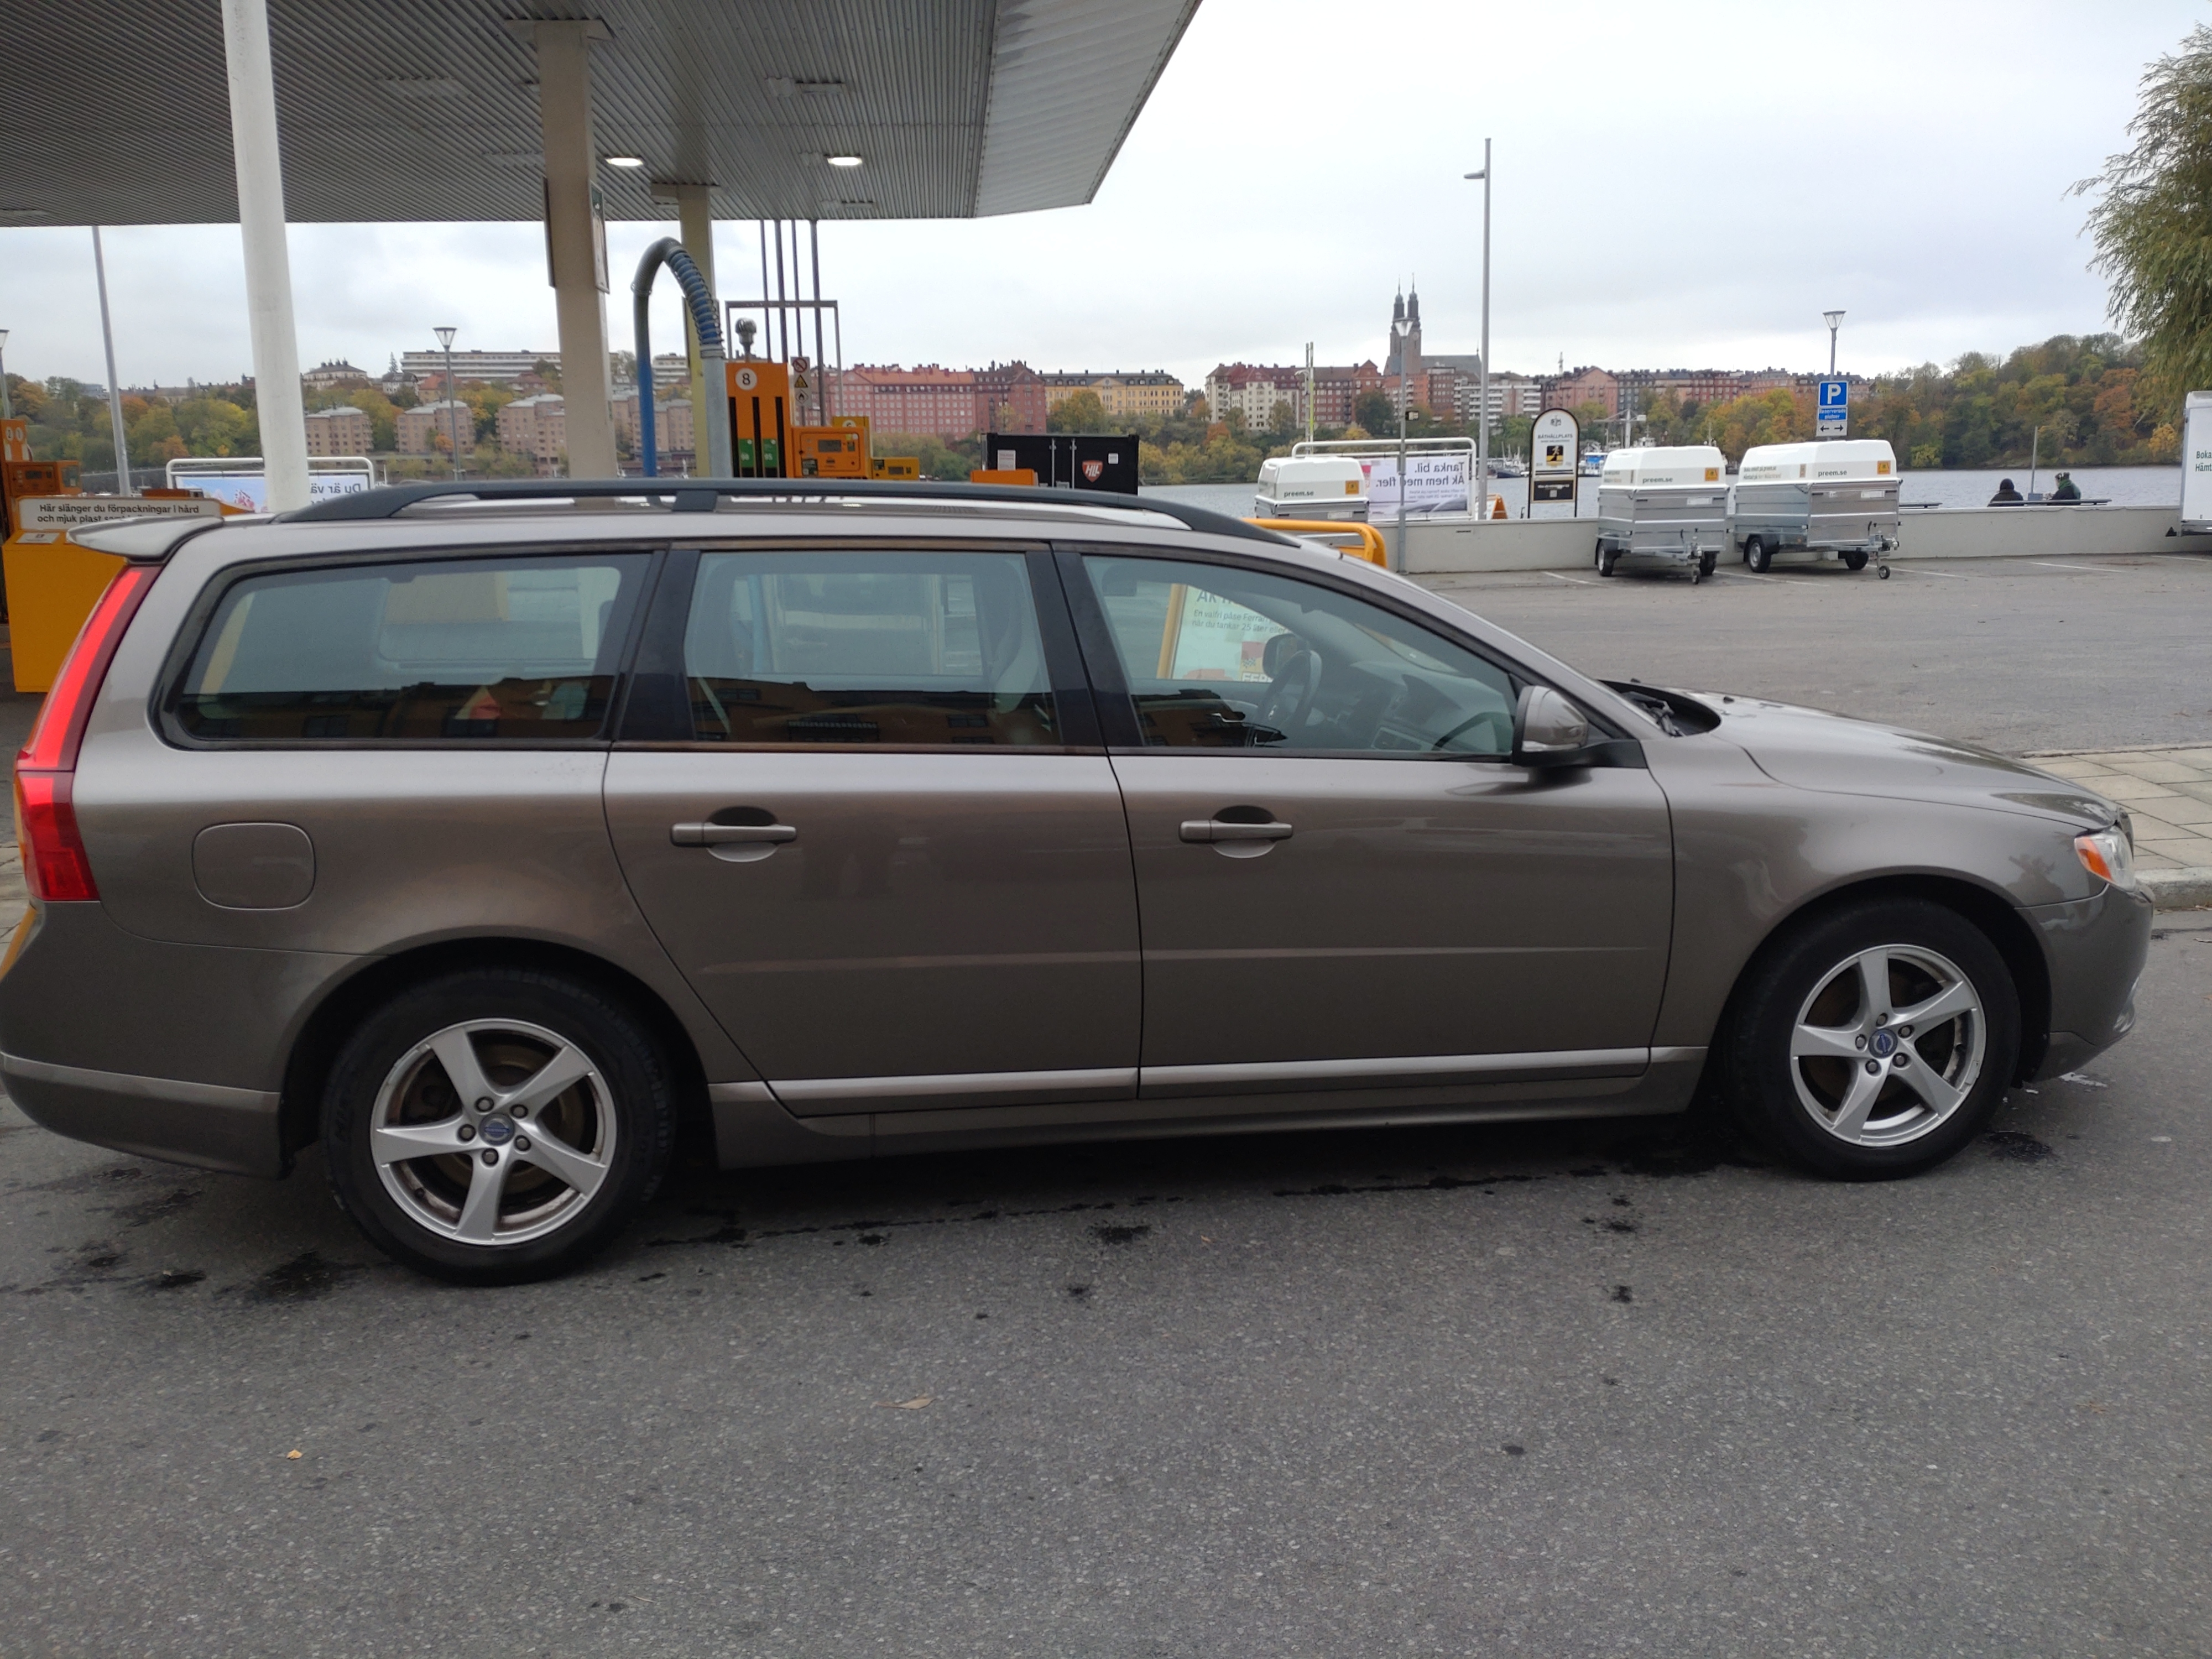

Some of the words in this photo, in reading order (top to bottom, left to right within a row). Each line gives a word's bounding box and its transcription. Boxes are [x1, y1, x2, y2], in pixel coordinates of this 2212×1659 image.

[742, 373, 751, 385] 8
[1827, 384, 1841, 404] P
[2196, 450, 2212, 459] Boka
[39, 504, 56, 512] Här
[58, 504, 91, 514] slänger
[107, 504, 171, 514] förpackningar
[178, 504, 199, 513] hård
[56, 514, 77, 524] mjuk
[79, 514, 102, 524] plast
[1204, 611, 1223, 619] valfri
[1223, 611, 1241, 622] påse
[1205, 620, 1215, 629] du
[1217, 621, 1240, 630] tankar
[1241, 623, 1251, 632] 25
[1253, 624, 1267, 633] liter
